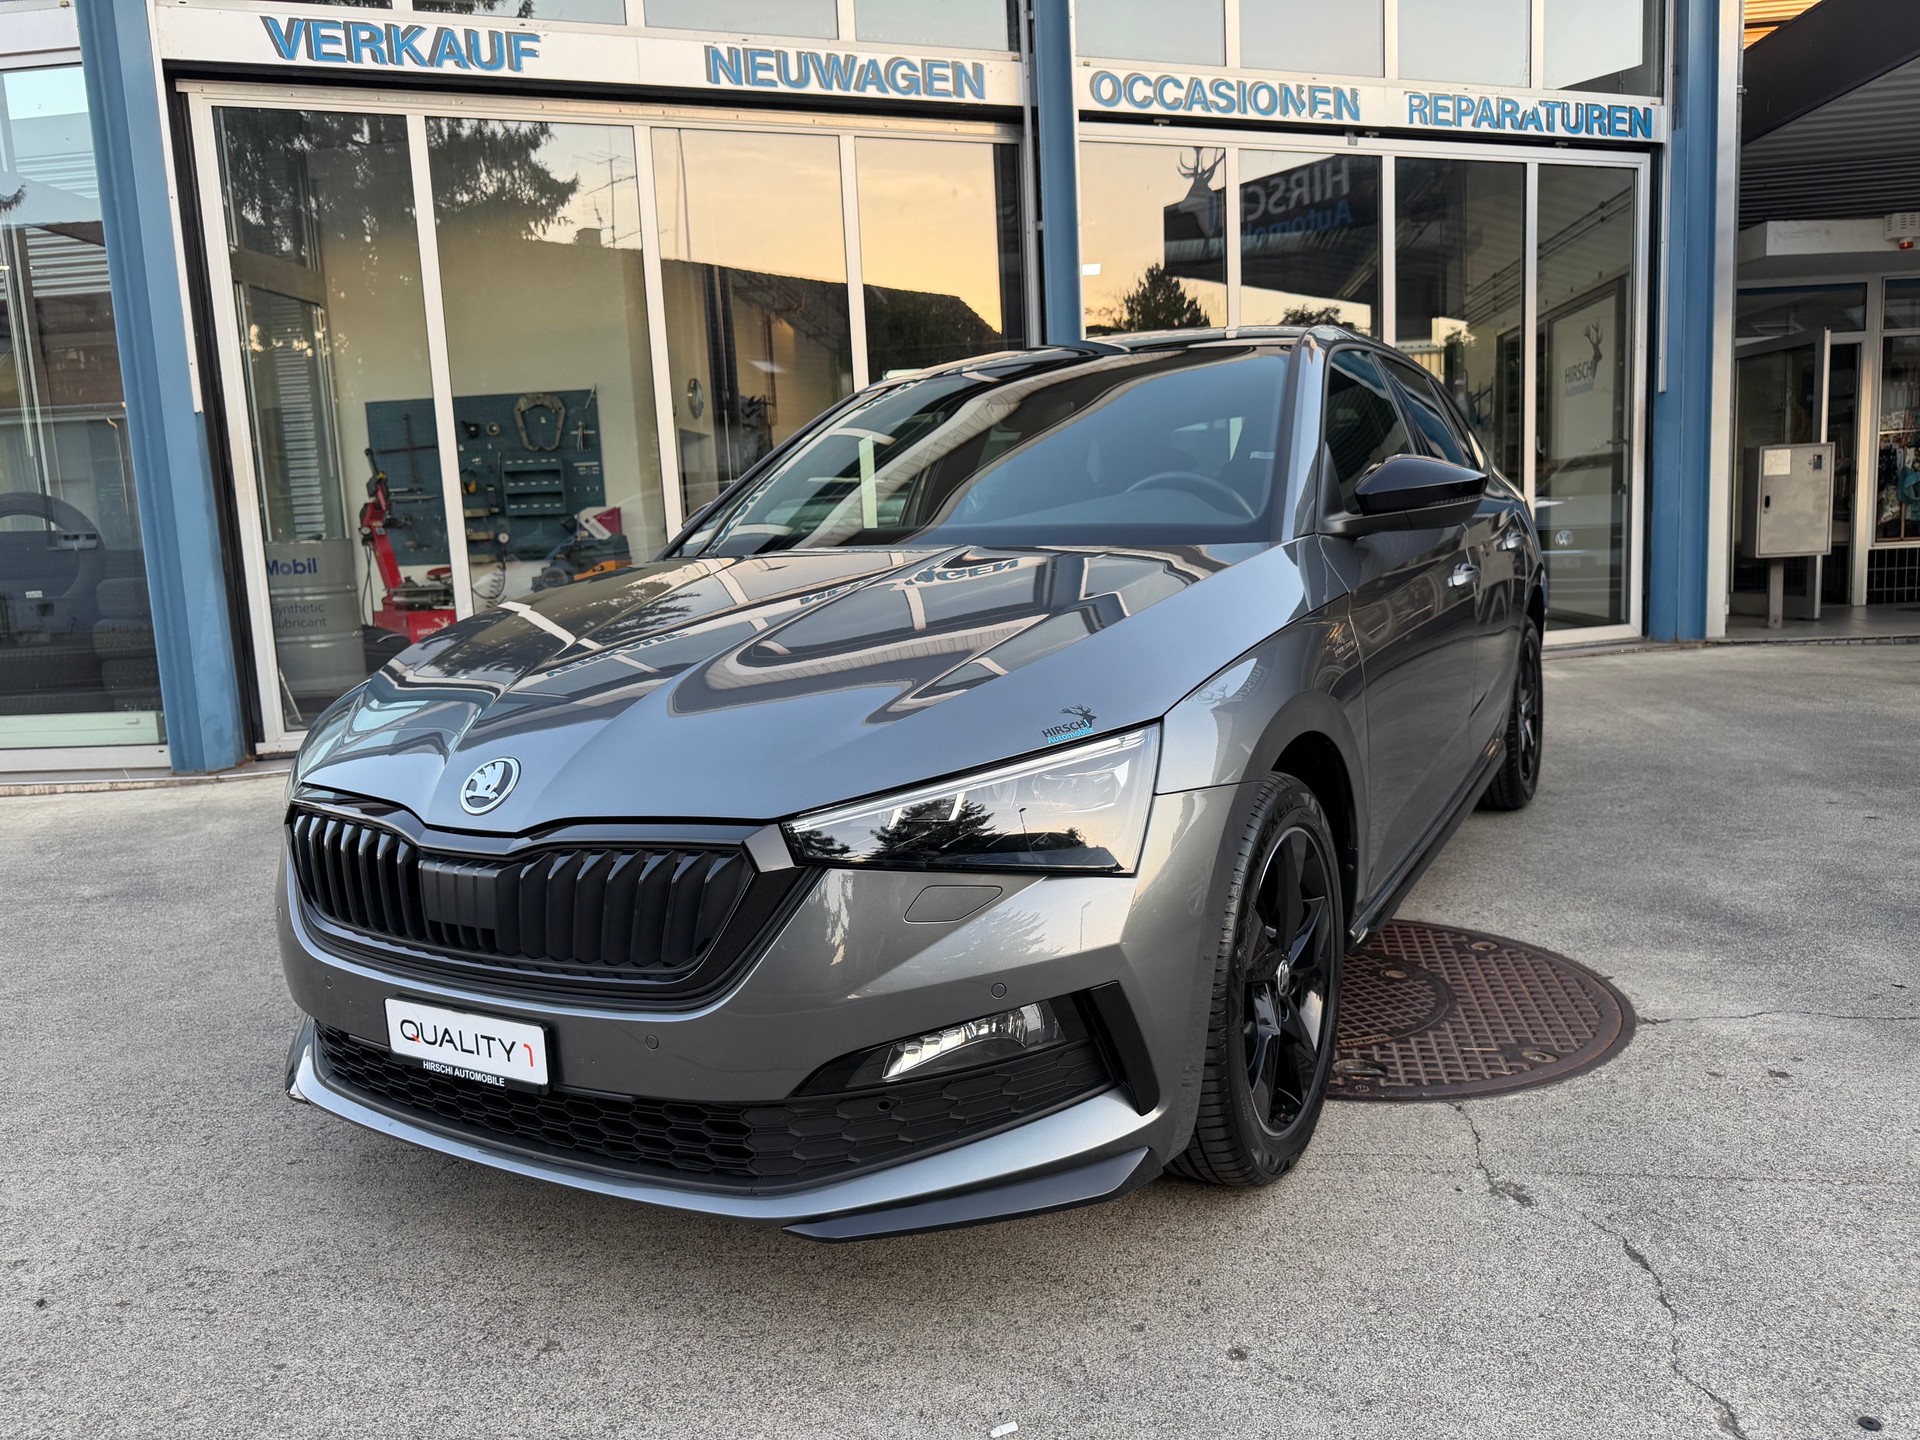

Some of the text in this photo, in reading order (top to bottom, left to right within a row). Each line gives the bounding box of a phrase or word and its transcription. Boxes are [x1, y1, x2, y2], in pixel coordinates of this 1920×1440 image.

[259, 15, 541, 73] VERKAUF
[704, 44, 985, 100] NEUWAGEN
[1090, 70, 1361, 122] OCCASIONEN
[1404, 90, 1652, 139] REPARATUREN
[266, 557, 318, 576] Mobil
[271, 602, 325, 617] Synthetic
[1047, 726, 1095, 744] Automobile
[400, 1019, 534, 1067] QUALITY 1
[422, 1060, 506, 1087] HIRSCHI AUTOMOBILE
